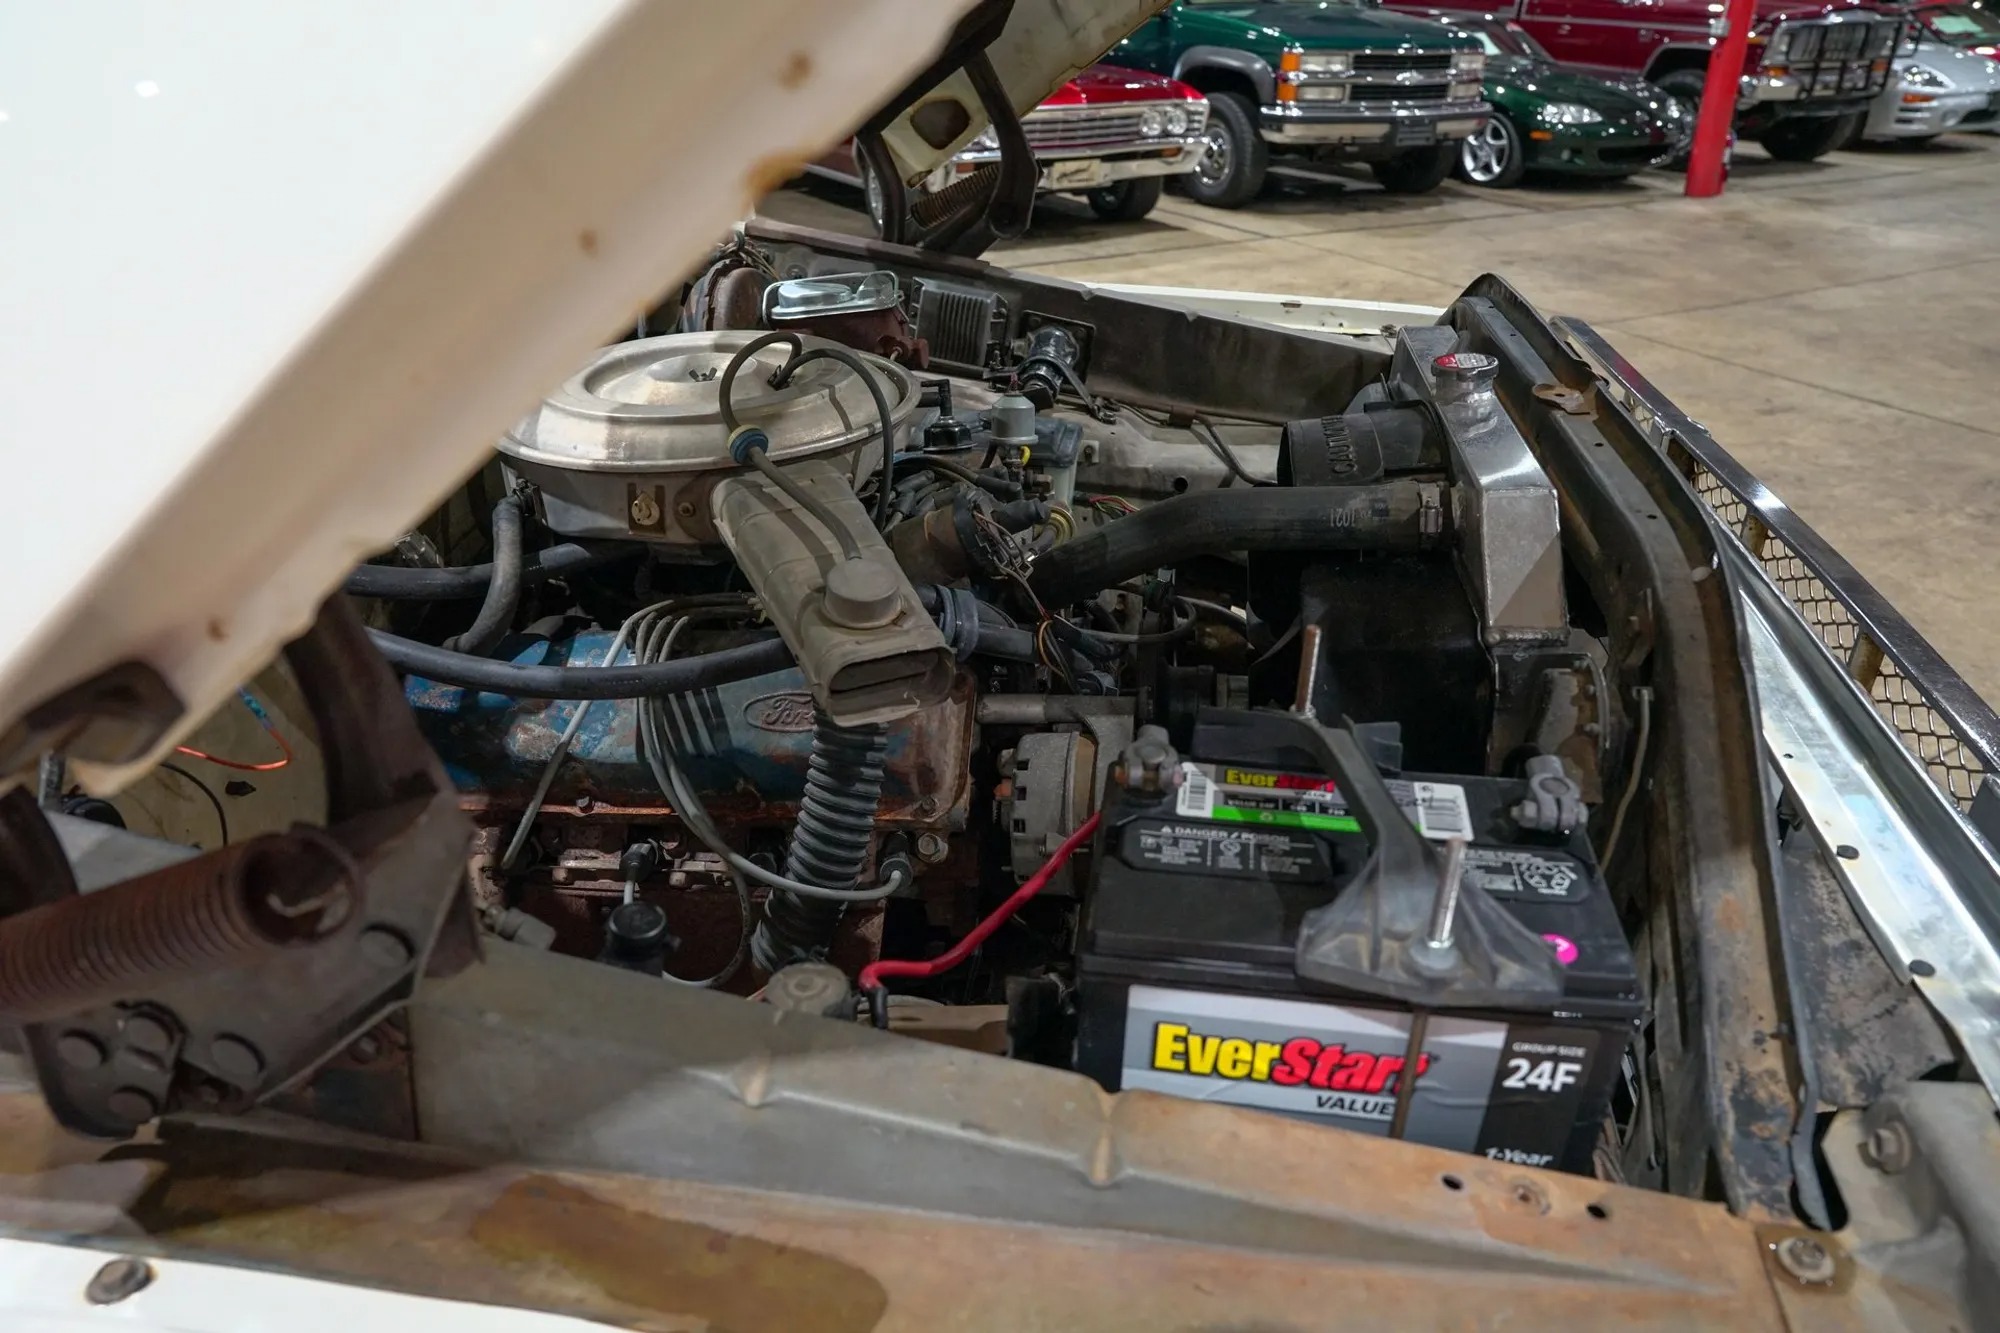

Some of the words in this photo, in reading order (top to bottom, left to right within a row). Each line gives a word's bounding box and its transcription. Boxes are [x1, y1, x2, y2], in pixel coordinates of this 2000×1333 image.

[1174, 826, 1229, 839] DANGER
[1241, 832, 1290, 844] POISON
[1512, 1041, 1557, 1054] GROUP
[1558, 1045, 1586, 1058] SIZE
[1502, 1057, 1582, 1093] 24F
[1315, 1094, 1394, 1116] VALUE
[1485, 1146, 1554, 1166] 1-Year
